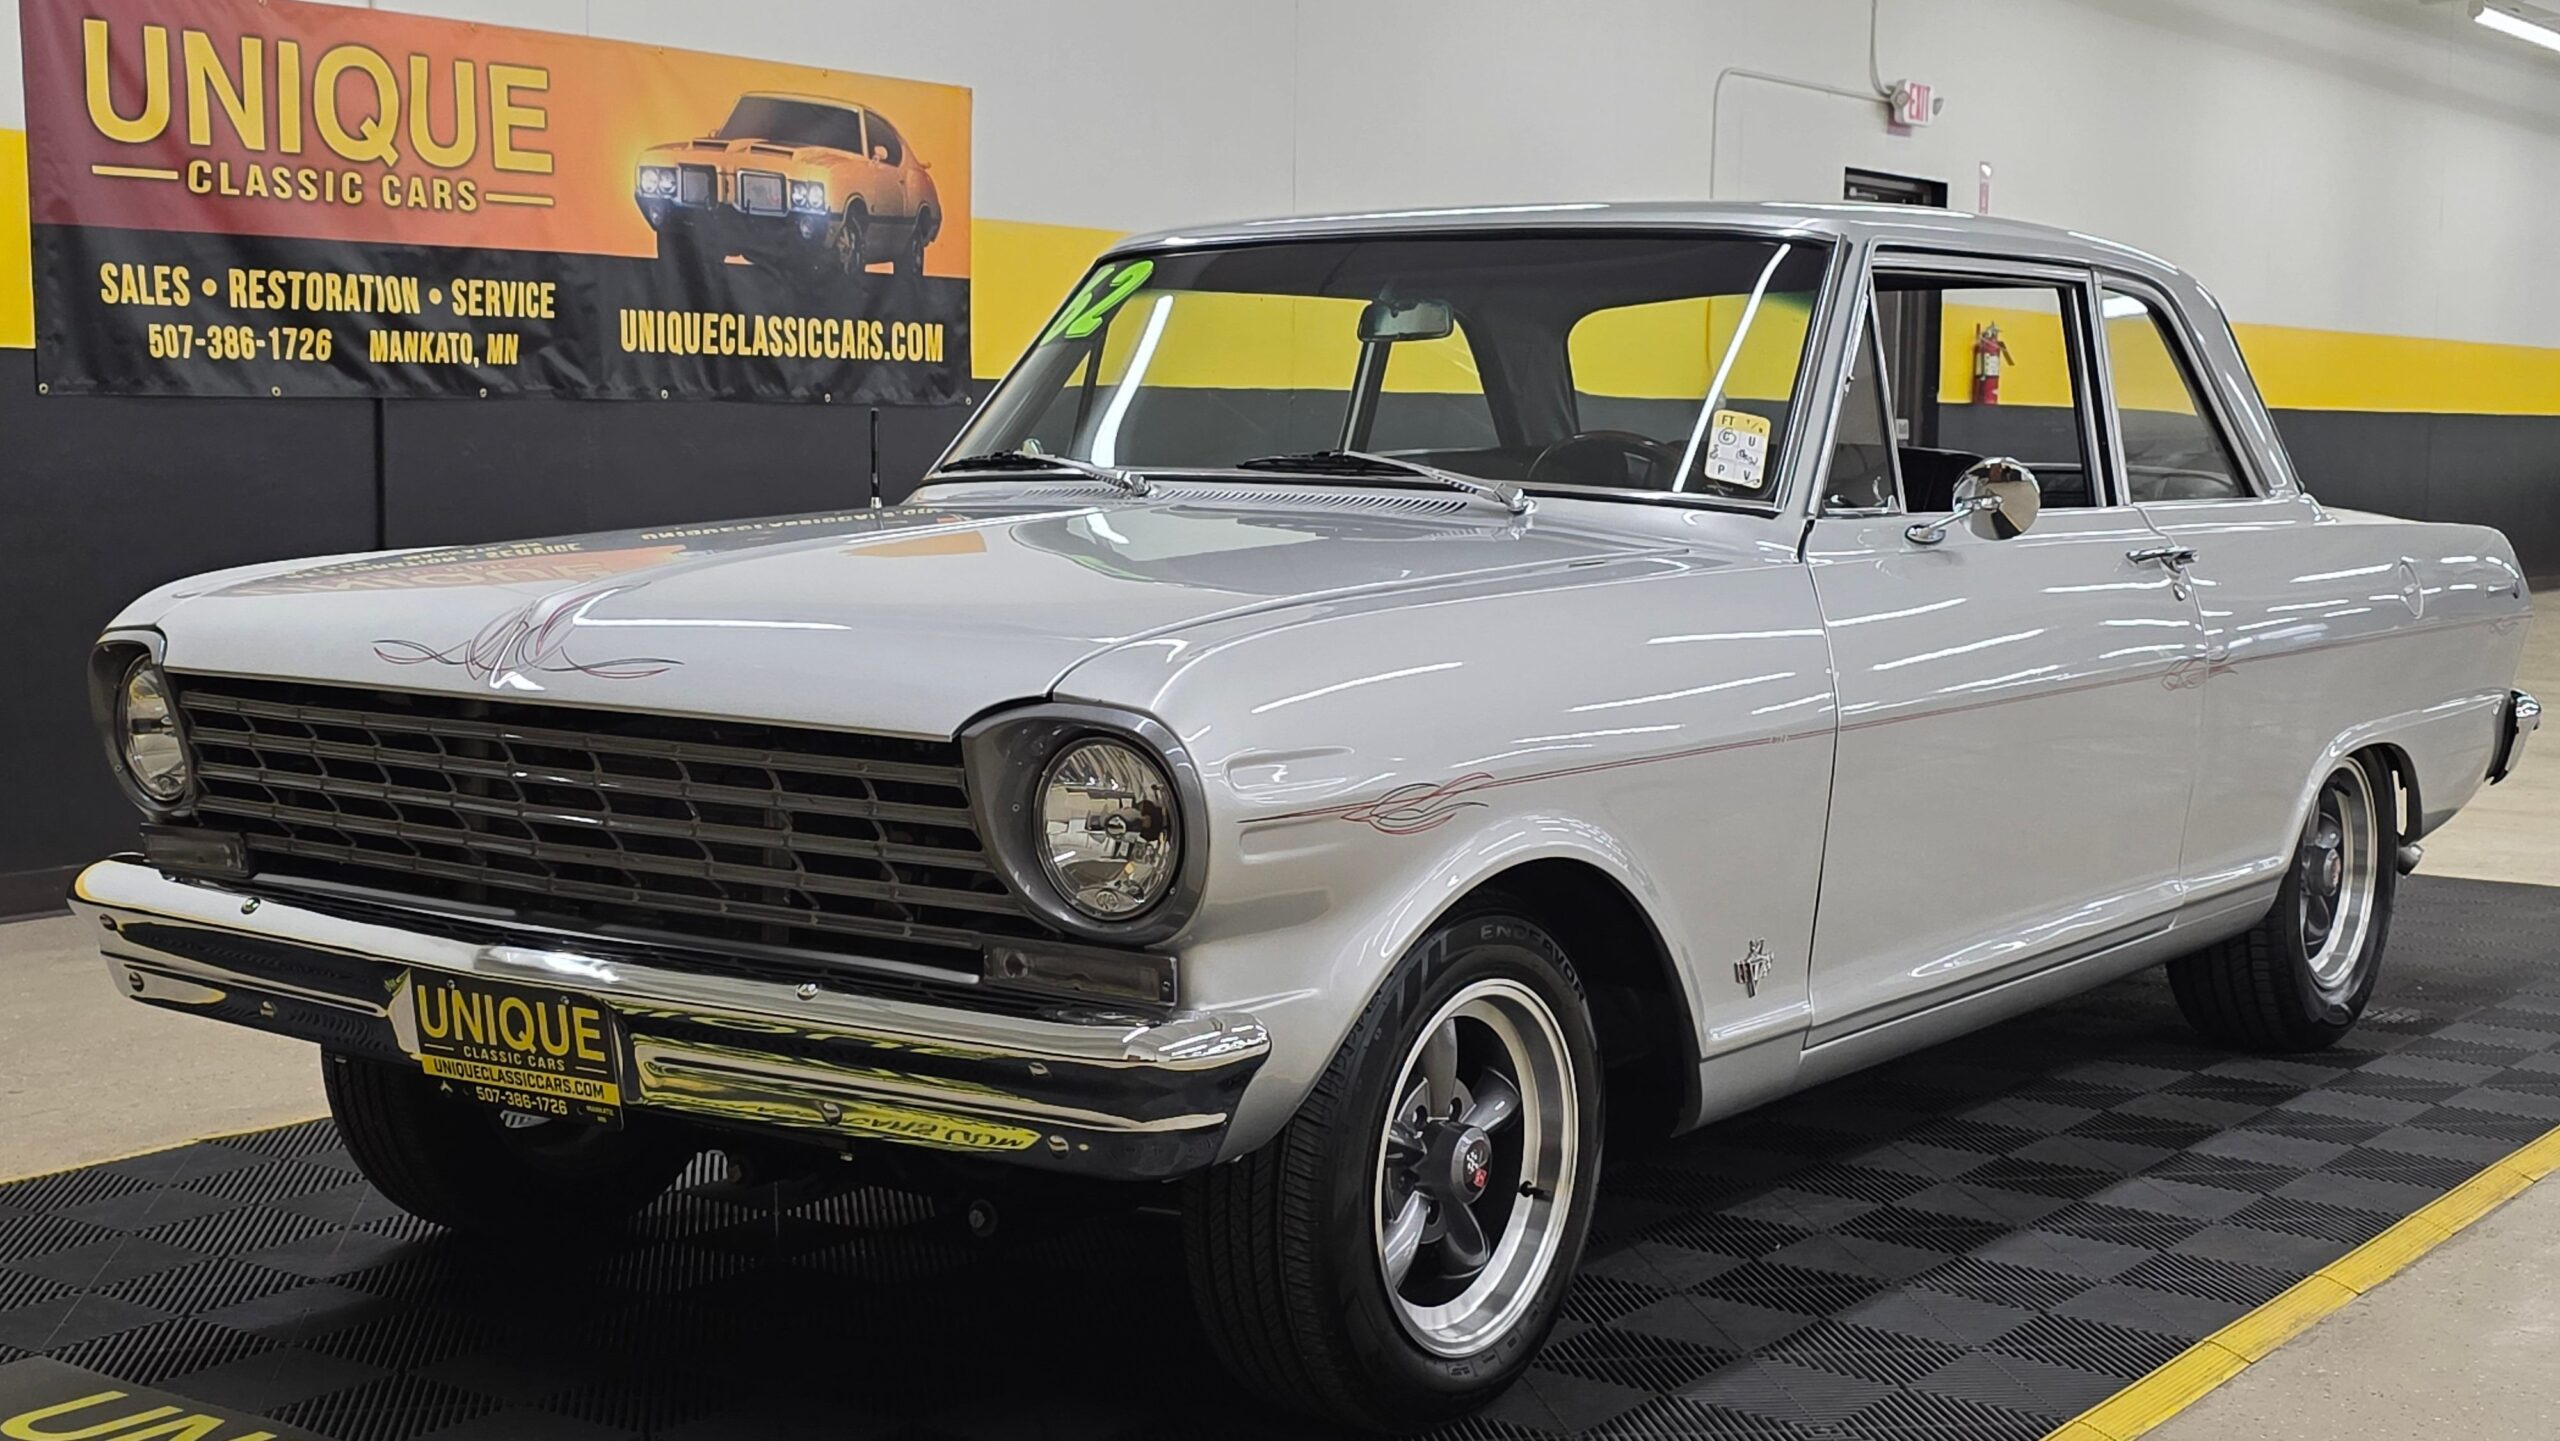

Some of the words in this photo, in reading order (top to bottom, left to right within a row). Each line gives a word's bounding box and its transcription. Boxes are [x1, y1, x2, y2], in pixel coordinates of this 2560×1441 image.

[83, 18, 554, 174] UNIQUE
[188, 159, 362, 206] CLASSIC
[382, 174, 478, 212] CARS
[100, 262, 190, 307] SALES
[228, 268, 420, 314] RESTORATION
[452, 279, 556, 319] SERVICE
[148, 323, 332, 362] 507-386-1726
[369, 330, 479, 368] MANKATO,
[486, 332, 519, 365] MN
[620, 308, 943, 363] UNIQUECLASSICCARS.COM
[1748, 436, 1756, 447] U
[1717, 464, 1725, 474] P
[417, 985, 606, 1062] UNIQUE
[434, 1060, 605, 1099] UNIQUECLASSICCARS.COM
[463, 1046, 522, 1066] CLASSIC
[527, 1055, 566, 1071] CARS
[476, 1086, 568, 1115] 507-386-1726
